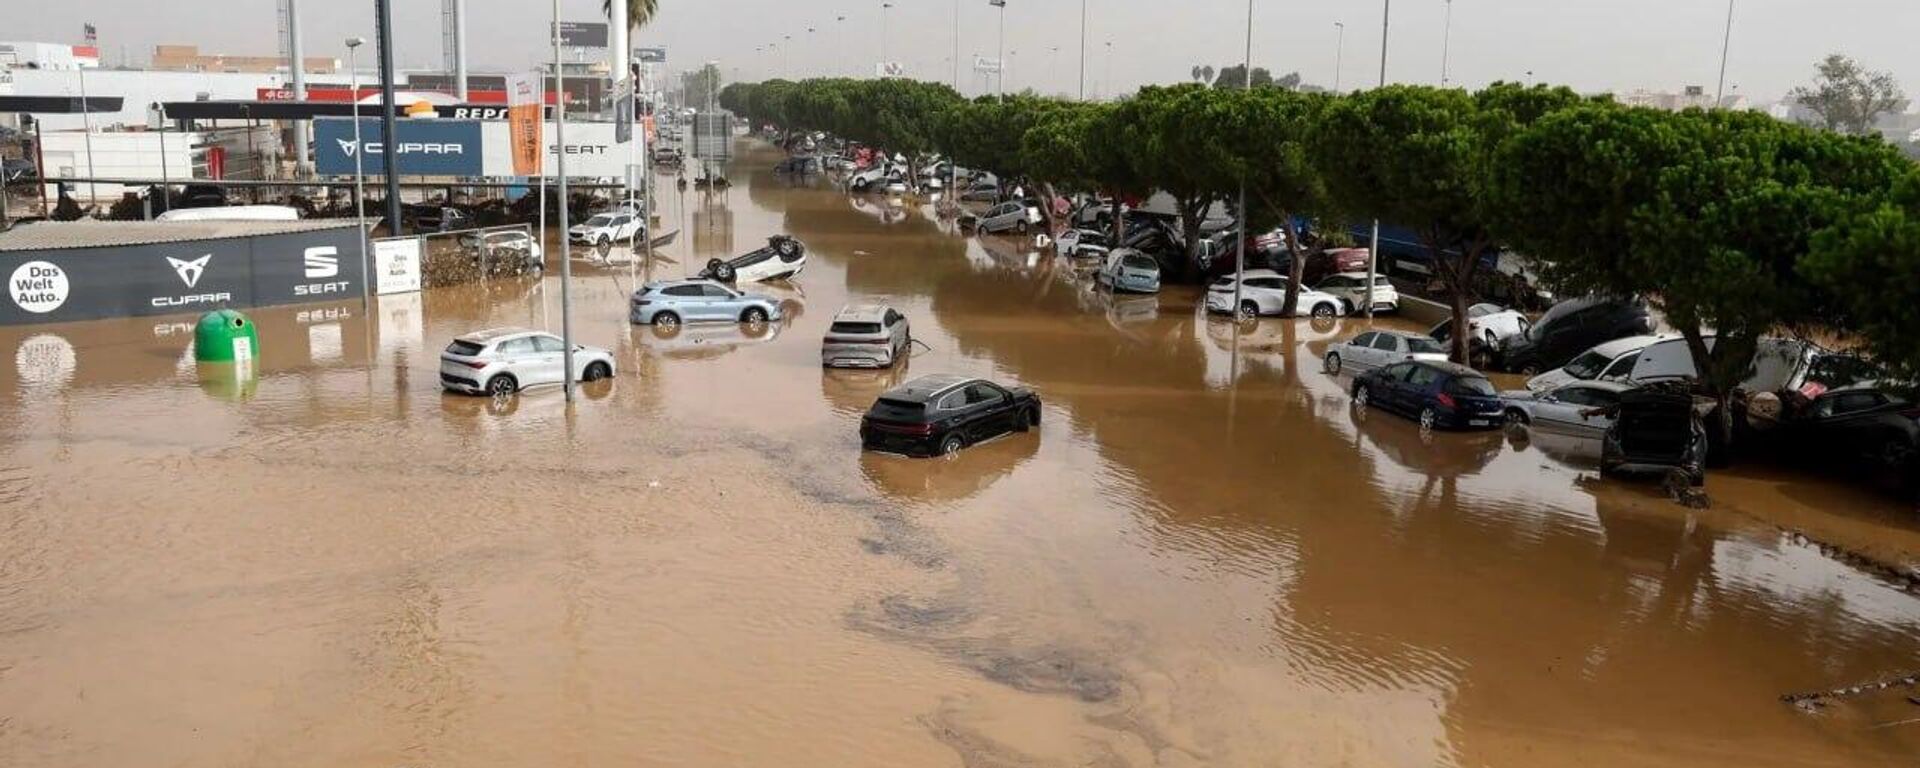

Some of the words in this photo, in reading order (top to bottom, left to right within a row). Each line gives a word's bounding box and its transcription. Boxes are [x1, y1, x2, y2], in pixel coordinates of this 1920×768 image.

[549, 145, 608, 154] SEAT
[30, 267, 59, 277] Das
[16, 278, 54, 291] Welt
[294, 281, 349, 295] SEAT
[19, 293, 60, 304] Auto.
[152, 292, 231, 306] CUPRA
